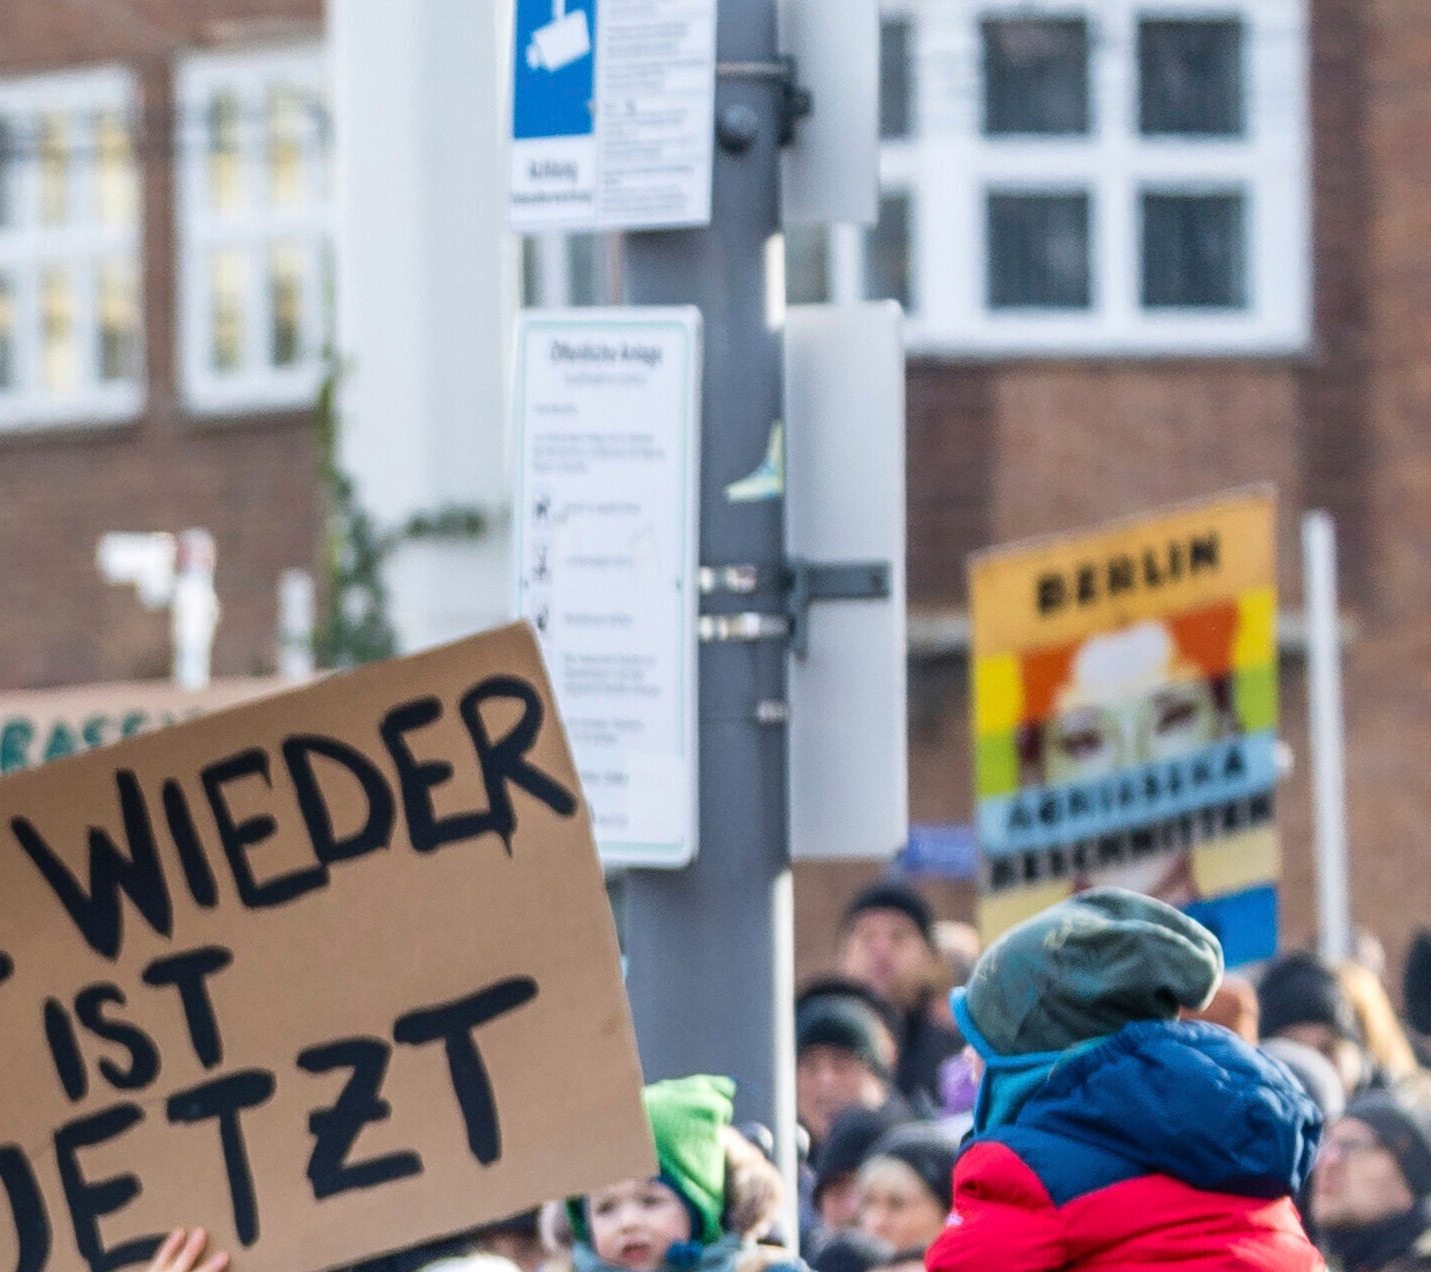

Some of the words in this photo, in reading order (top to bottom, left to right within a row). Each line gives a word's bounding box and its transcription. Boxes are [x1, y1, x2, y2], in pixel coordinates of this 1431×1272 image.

[1035, 531, 1222, 614] BERLIN
[9, 675, 577, 960] WIEDER
[42, 945, 234, 1103] IST
